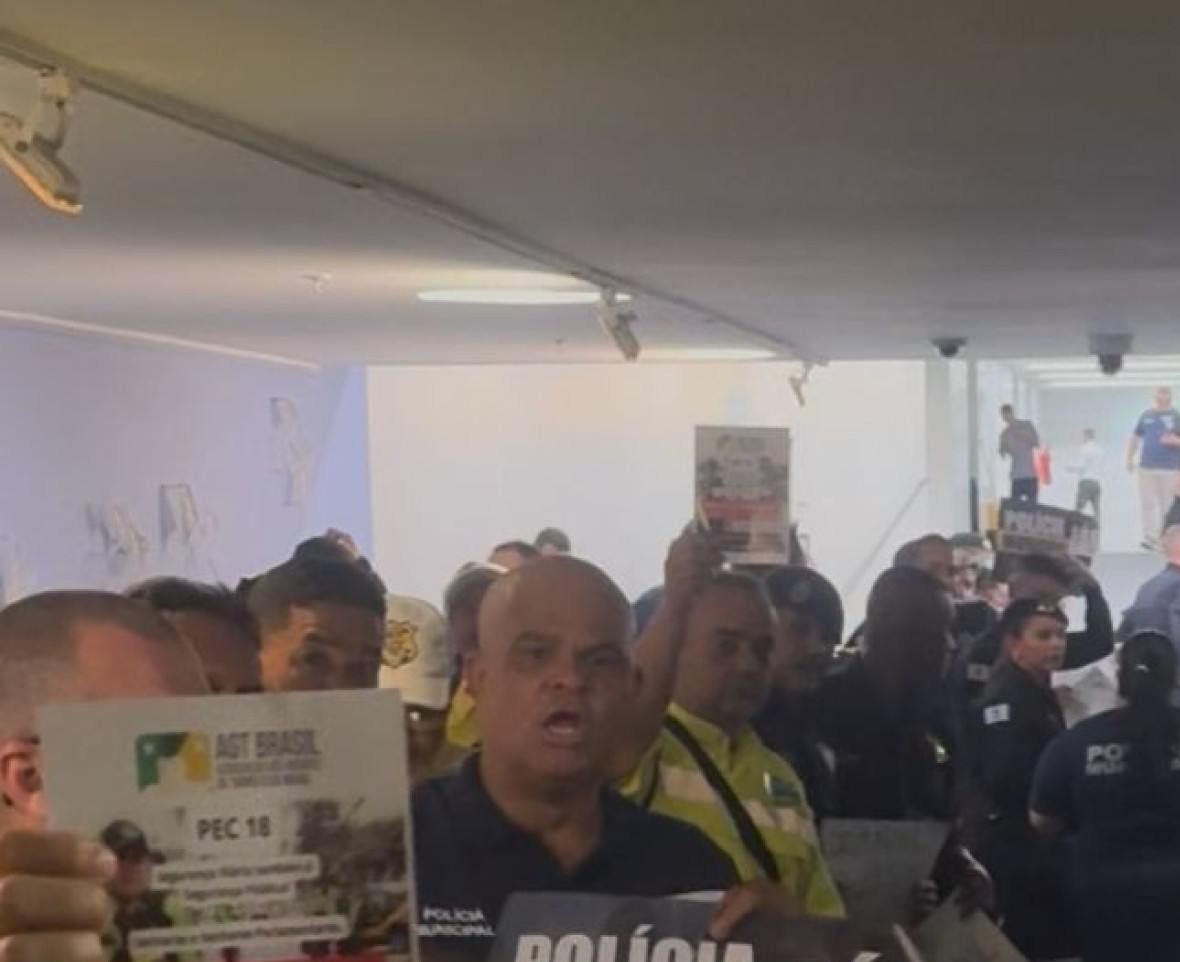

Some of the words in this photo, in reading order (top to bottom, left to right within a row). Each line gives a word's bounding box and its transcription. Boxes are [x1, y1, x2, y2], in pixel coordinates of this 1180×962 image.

[254, 729, 322, 758] BRASIL
[196, 816, 240, 841] PEC
[246, 815, 271, 837] 18
